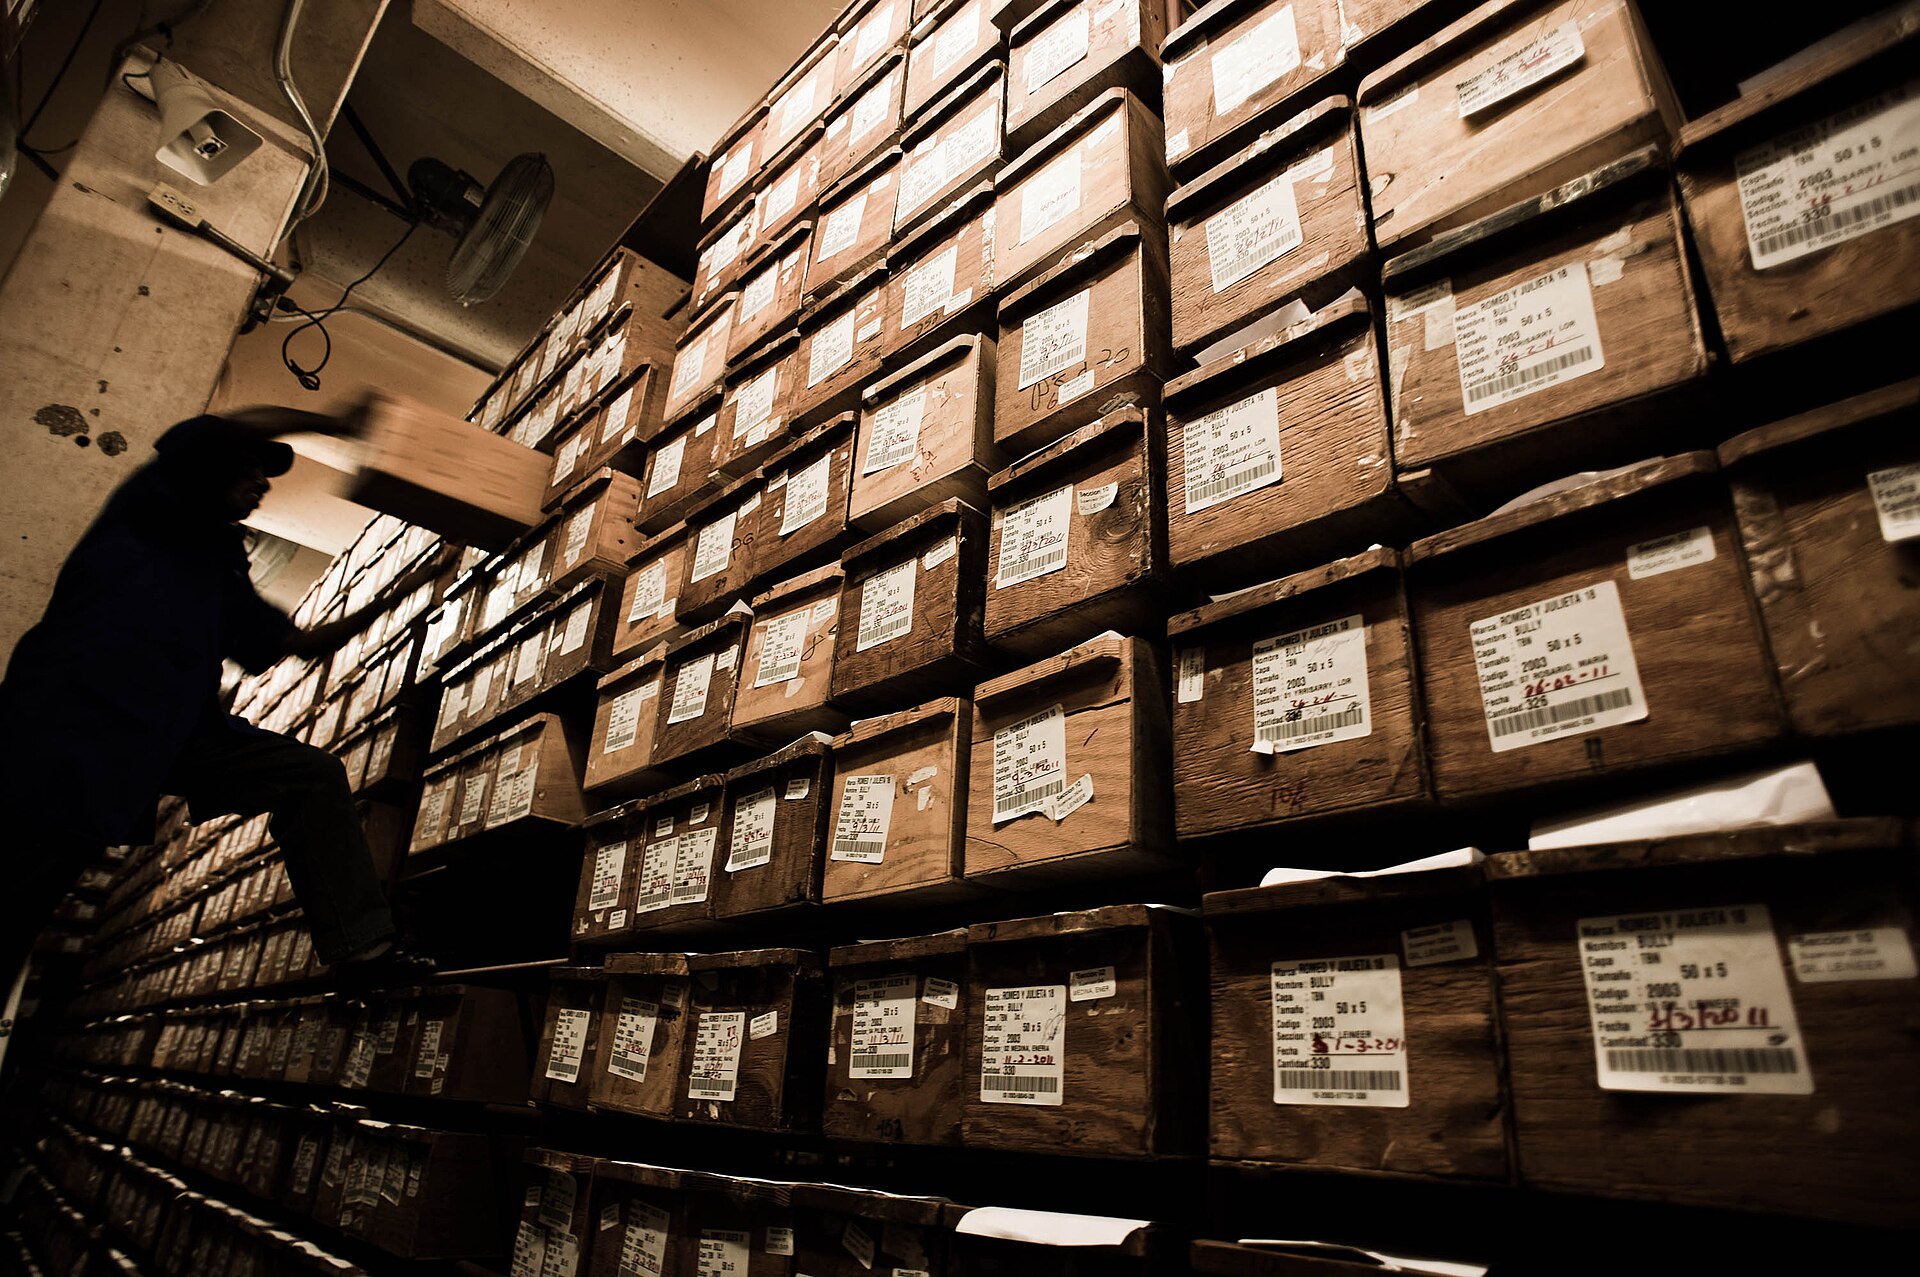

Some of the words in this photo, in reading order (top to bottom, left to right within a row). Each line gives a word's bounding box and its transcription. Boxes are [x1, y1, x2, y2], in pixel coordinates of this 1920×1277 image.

[1203, 411, 1223, 425] ROMEO
[1231, 398, 1254, 413] JULIETA
[1185, 431, 1205, 441] Nombre
[1211, 419, 1228, 431] BULLY
[1230, 430, 1238, 440] 50
[1185, 441, 1198, 449] Capa
[1212, 444, 1228, 457] 2003
[1187, 474, 1201, 483] Fecha
[1499, 609, 1532, 626] ROMEO
[1533, 605, 1540, 616] Y
[1543, 594, 1581, 613] JULIETA
[1276, 634, 1299, 648] ROMEO
[1302, 632, 1306, 641] Y
[1308, 624, 1337, 639] JULIETA
[1474, 633, 1506, 647] Nombre
[1514, 619, 1543, 636] BULLY
[1546, 638, 1561, 652] 50
[1572, 633, 1582, 645] 5
[1255, 654, 1278, 664] Nombre
[1285, 645, 1305, 657] BULLY
[1476, 647, 1496, 658] Capa
[1255, 666, 1269, 674] Capa
[1307, 662, 1317, 673] 50
[1327, 658, 1333, 668] 5
[1521, 656, 1547, 672] 2003
[1286, 677, 1305, 690] 2003
[1485, 695, 1509, 707] Fecha
[1256, 708, 1274, 717] Fecha
[1618, 916, 1662, 932] ROMEO
[1676, 910, 1728, 928] JULIETA
[1637, 933, 1675, 948] BULLY
[1299, 961, 1327, 973] ROMEO
[1329, 961, 1335, 971] Y
[1338, 959, 1371, 971] JULIETA
[1587, 955, 1614, 966] Capa
[1679, 962, 1700, 978] 50
[1275, 981, 1302, 989] Nombre
[1310, 976, 1335, 988] BULLY
[1646, 982, 1681, 997] 2003
[1275, 992, 1293, 1001] Capa
[1336, 1001, 1348, 1013] 50
[1351, 1005, 1356, 1013] x
[1359, 1000, 1366, 1013] 5
[1276, 1019, 1300, 1029] Codigo
[1312, 1016, 1334, 1028] 2003
[1597, 1021, 1631, 1031] Fecha
[1277, 1046, 1298, 1054] Fecha
[1312, 1056, 1330, 1068] 330
